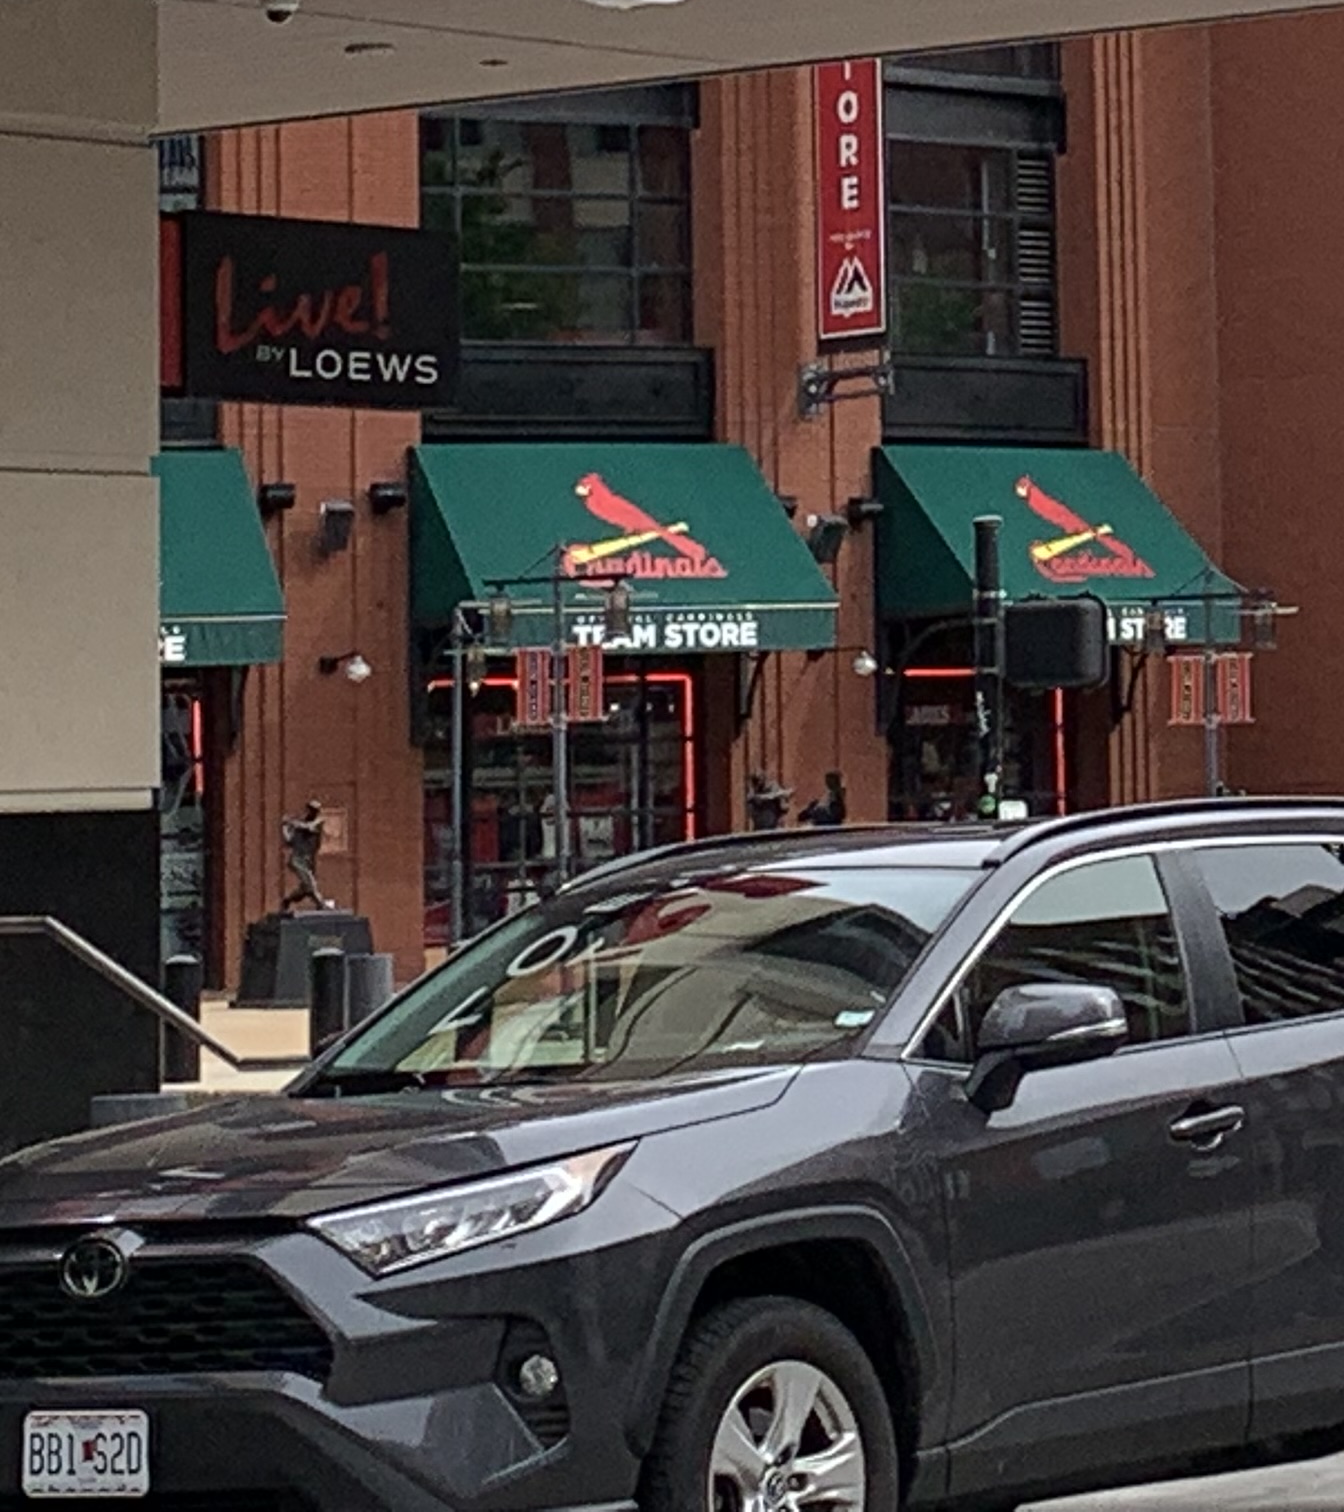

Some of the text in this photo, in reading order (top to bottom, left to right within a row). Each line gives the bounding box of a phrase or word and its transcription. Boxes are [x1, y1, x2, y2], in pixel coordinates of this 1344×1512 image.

[214, 251, 392, 354] Live!
[256, 345, 439, 385] BY LOEWS
[664, 621, 758, 649] STORE
[1119, 617, 1187, 640] STRE
